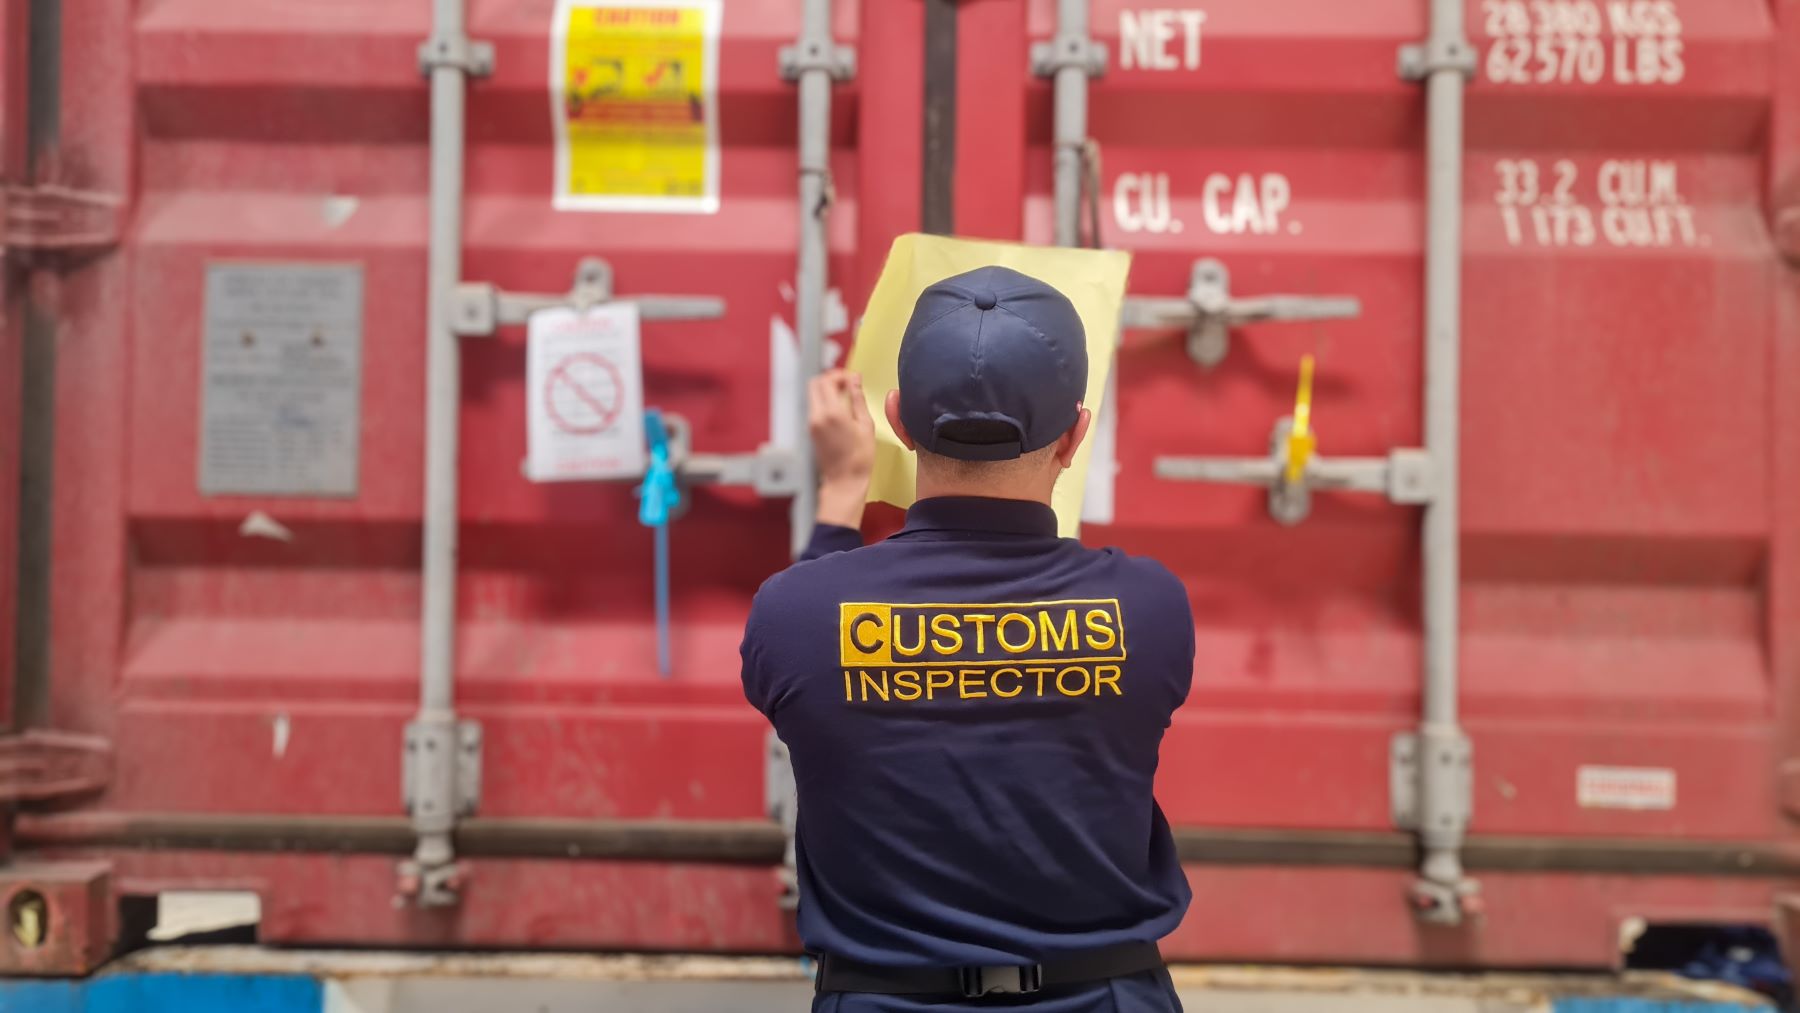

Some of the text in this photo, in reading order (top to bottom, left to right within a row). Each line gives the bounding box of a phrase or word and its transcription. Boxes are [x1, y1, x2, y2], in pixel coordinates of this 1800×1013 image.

[1118, 8, 1206, 71] NET
[1613, 37, 1685, 84] LBS
[1112, 172, 1303, 235] CU. CAP.
[850, 609, 1116, 656] CUSTOMS
[844, 665, 1122, 702] INSPECTOR
